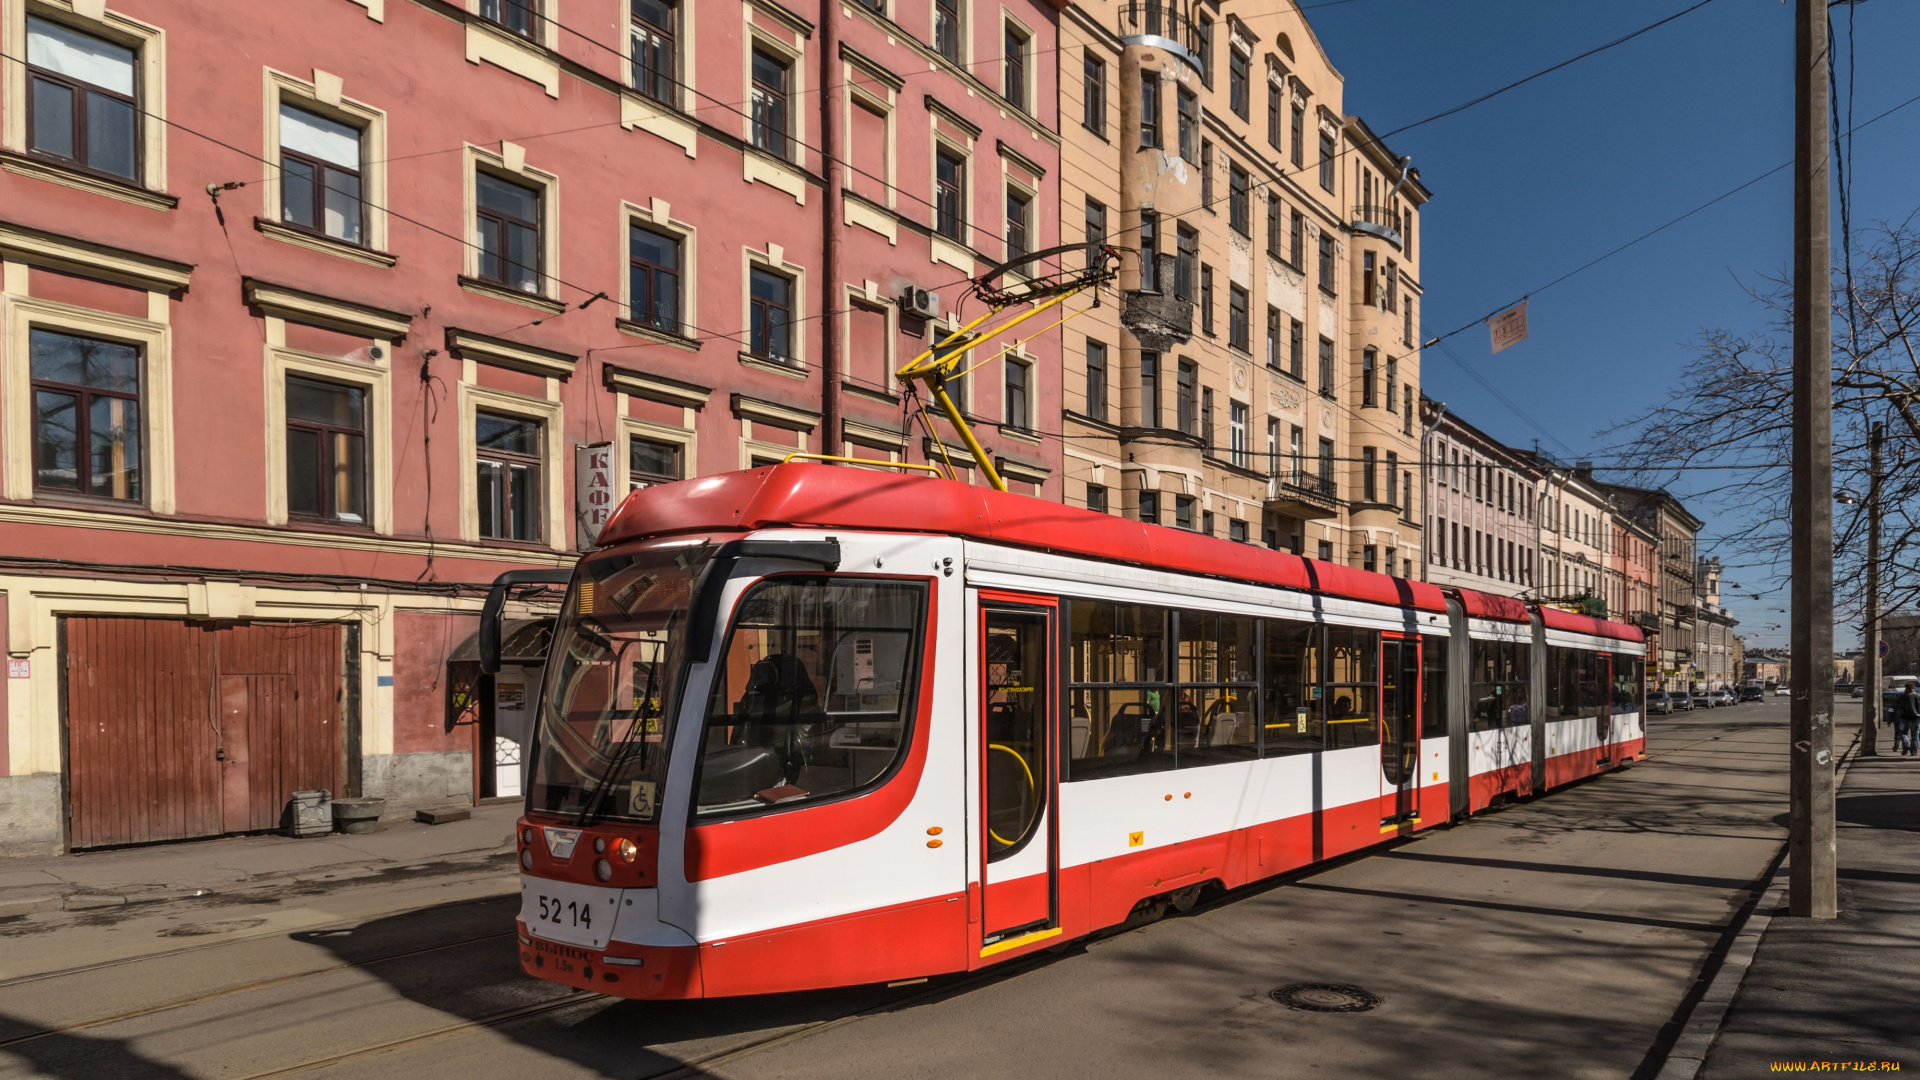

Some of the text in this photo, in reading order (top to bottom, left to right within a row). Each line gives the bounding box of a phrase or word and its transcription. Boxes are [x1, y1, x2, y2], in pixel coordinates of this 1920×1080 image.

[588, 454, 610, 524] КАФЕ
[539, 895, 592, 929] 5214
[535, 941, 594, 962] ВЫНОС
